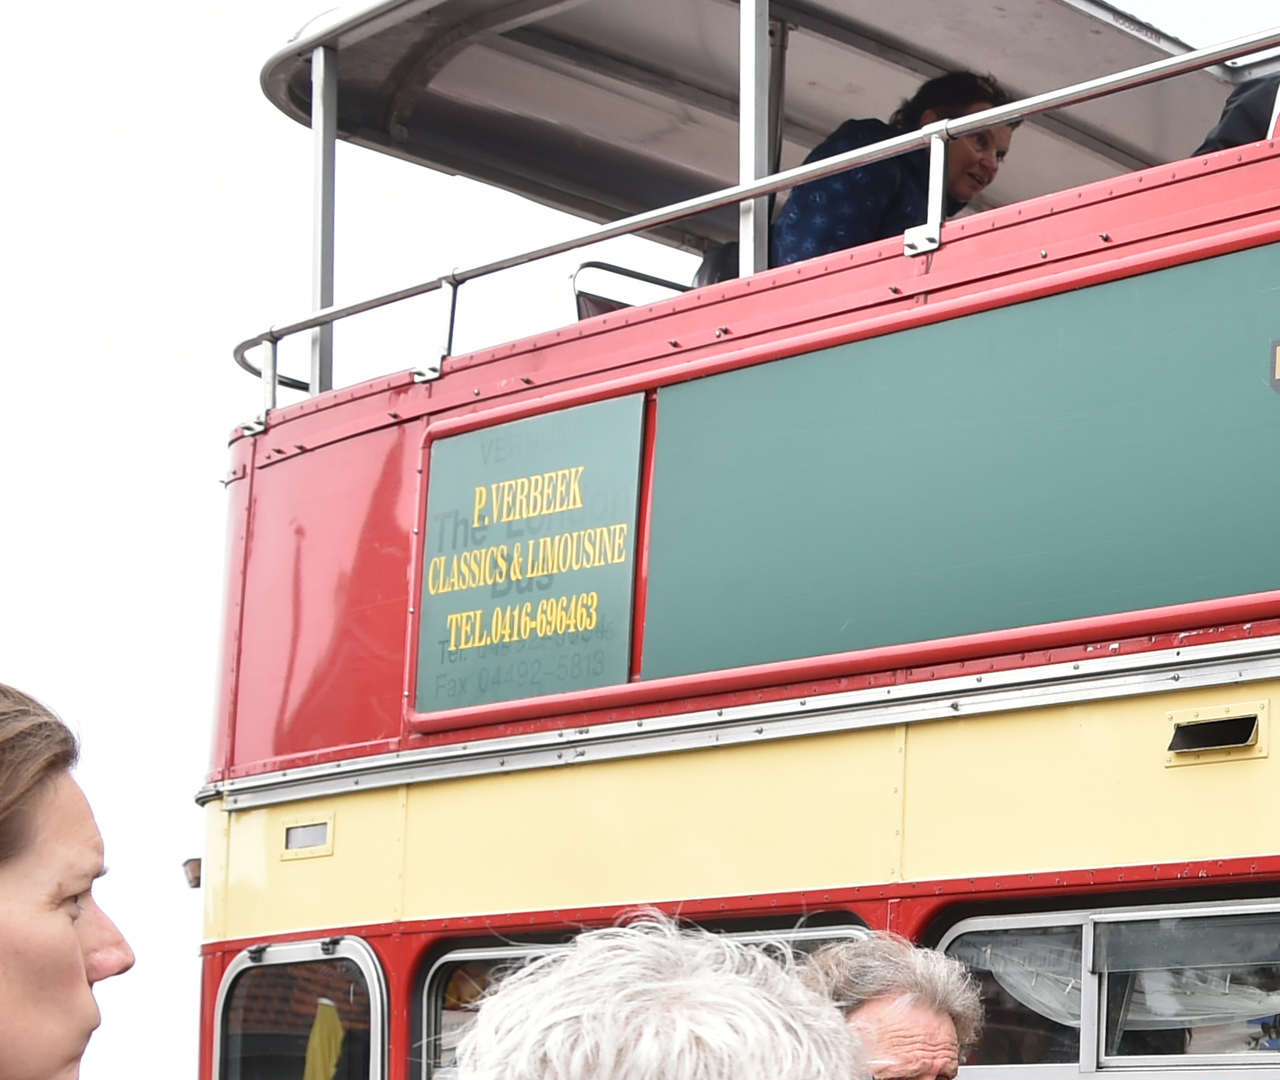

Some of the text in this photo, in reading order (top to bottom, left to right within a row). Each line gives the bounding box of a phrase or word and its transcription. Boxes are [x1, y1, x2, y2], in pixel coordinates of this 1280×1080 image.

[472, 465, 586, 529] P.VERBEEK
[428, 522, 628, 596] CLASSICS & LIMOUSINE
[446, 590, 600, 652] TEL.0416-696463
